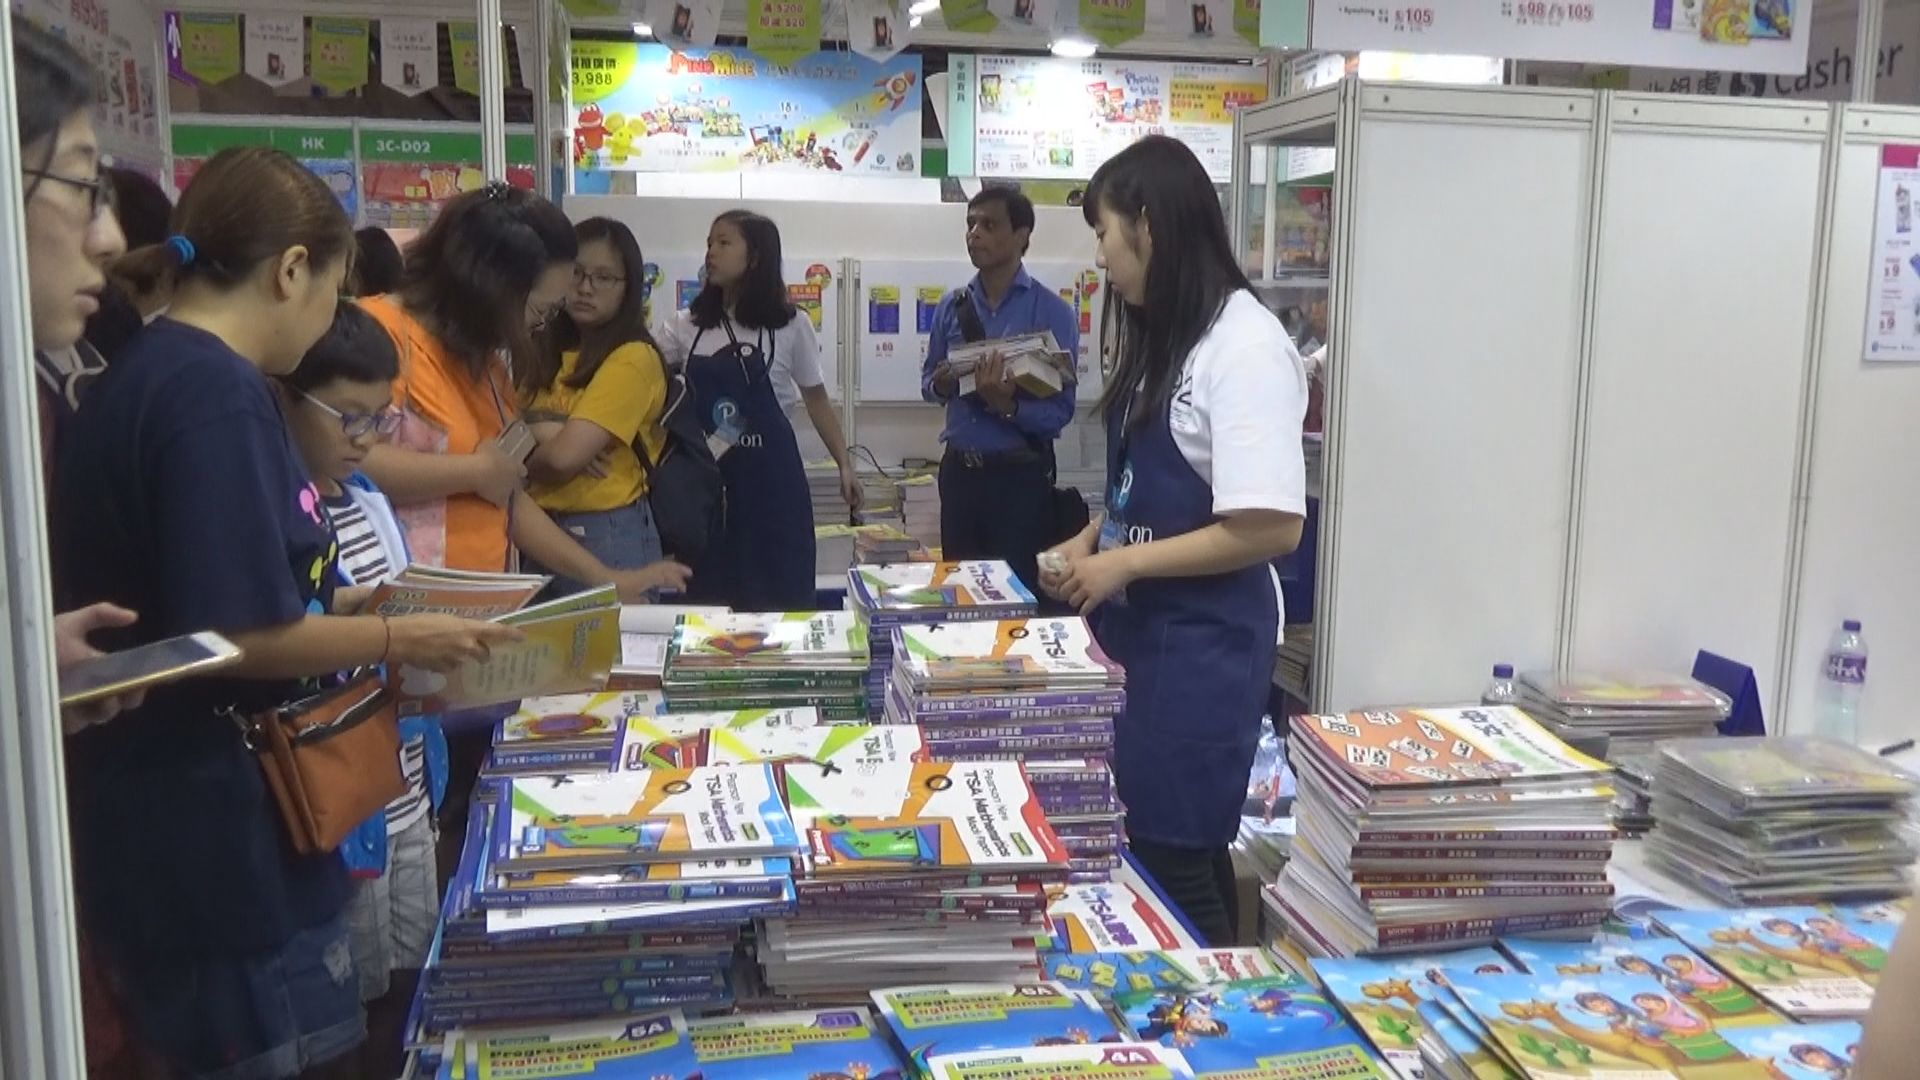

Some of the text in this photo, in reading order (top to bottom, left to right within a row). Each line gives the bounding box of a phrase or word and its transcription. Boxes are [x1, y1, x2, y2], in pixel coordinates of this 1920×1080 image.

[302, 137, 325, 150] HK
[376, 140, 430, 153] 3C-D02
[902, 997, 1000, 1008] Progressive
[692, 1029, 795, 1042] Progressive
[490, 1042, 604, 1058] Progressive
[1110, 1051, 1148, 1064] 4A
